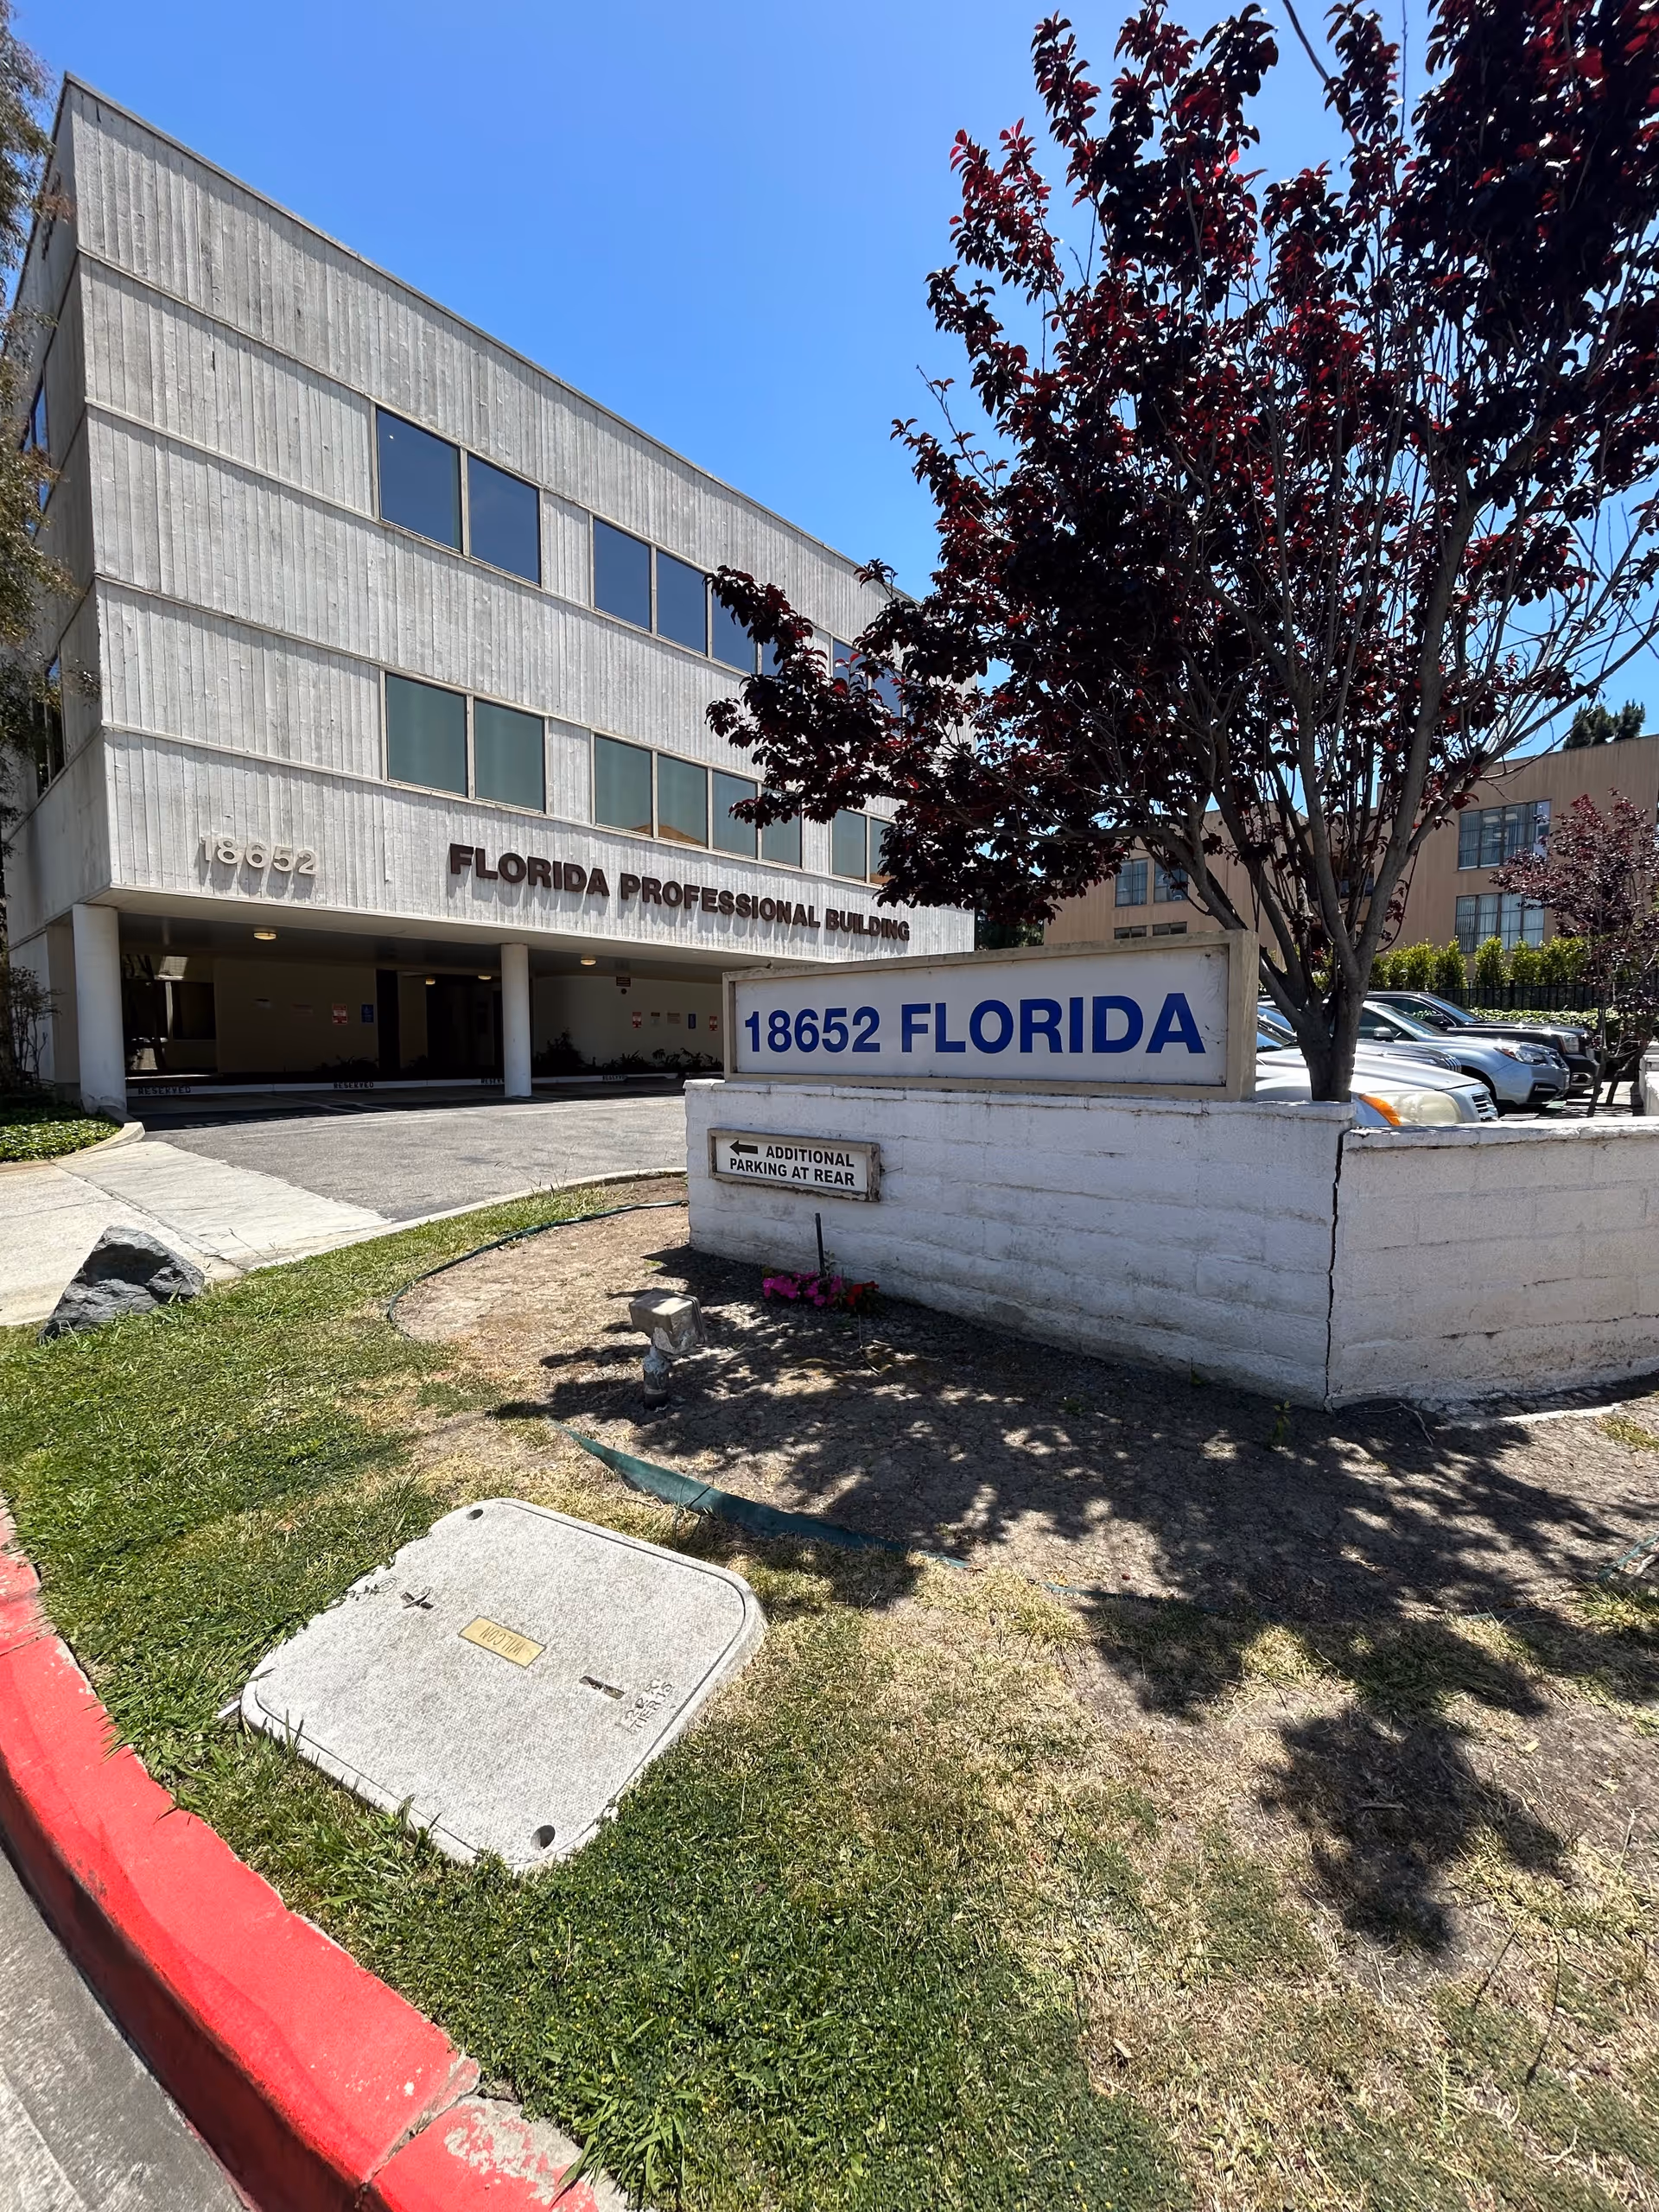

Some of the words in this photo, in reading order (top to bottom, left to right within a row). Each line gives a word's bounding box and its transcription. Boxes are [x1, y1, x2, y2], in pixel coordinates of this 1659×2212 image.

[200, 836, 318, 875] 18652
[448, 842, 610, 896] FLORIDA
[620, 873, 821, 928] PROFESSIONAL
[825, 908, 910, 941] BUILDING
[745, 1006, 881, 1053] 18652
[901, 992, 1206, 1054] FLORIDA
[137, 1085, 191, 1095] RESERVED
[730, 1158, 787, 1177] PARKING
[791, 1166, 809, 1180] AT
[815, 1168, 855, 1186] REAR
[766, 1146, 855, 1167] ADDITIONAL
[479, 1625, 525, 1656] WILCON
